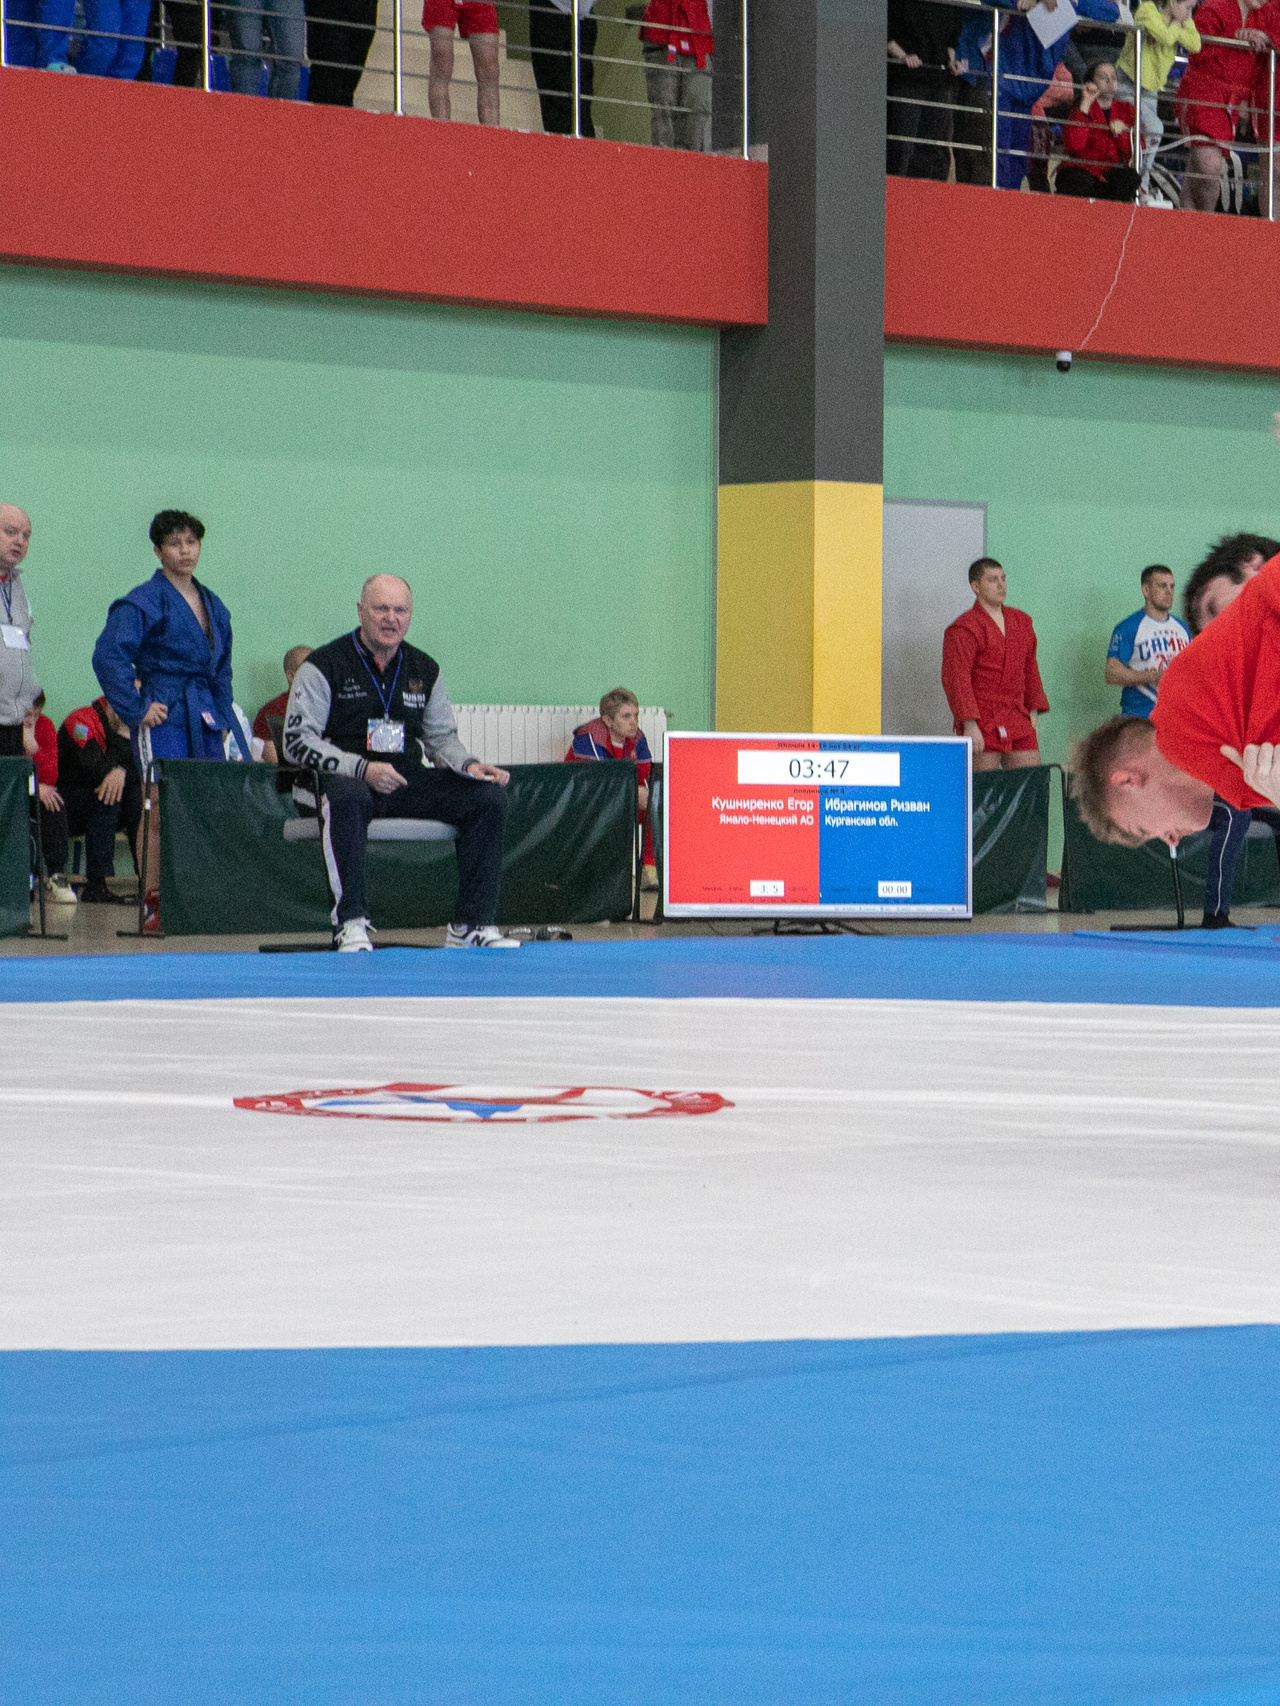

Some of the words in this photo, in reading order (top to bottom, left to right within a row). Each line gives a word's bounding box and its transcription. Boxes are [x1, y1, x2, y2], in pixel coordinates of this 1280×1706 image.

[285, 714, 340, 771] SAMBO
[789, 758, 850, 779] 03:47
[711, 796, 784, 811] Кушниренко
[787, 797, 814, 812] Егор
[825, 797, 888, 813] Ибрагимов
[890, 799, 930, 812] Ризван
[719, 814, 798, 826] Ямало-Ненецкий
[800, 815, 814, 825] АО
[825, 815, 877, 827] Курганская
[879, 815, 899, 827] обл.
[882, 885, 908, 895] 00:00
